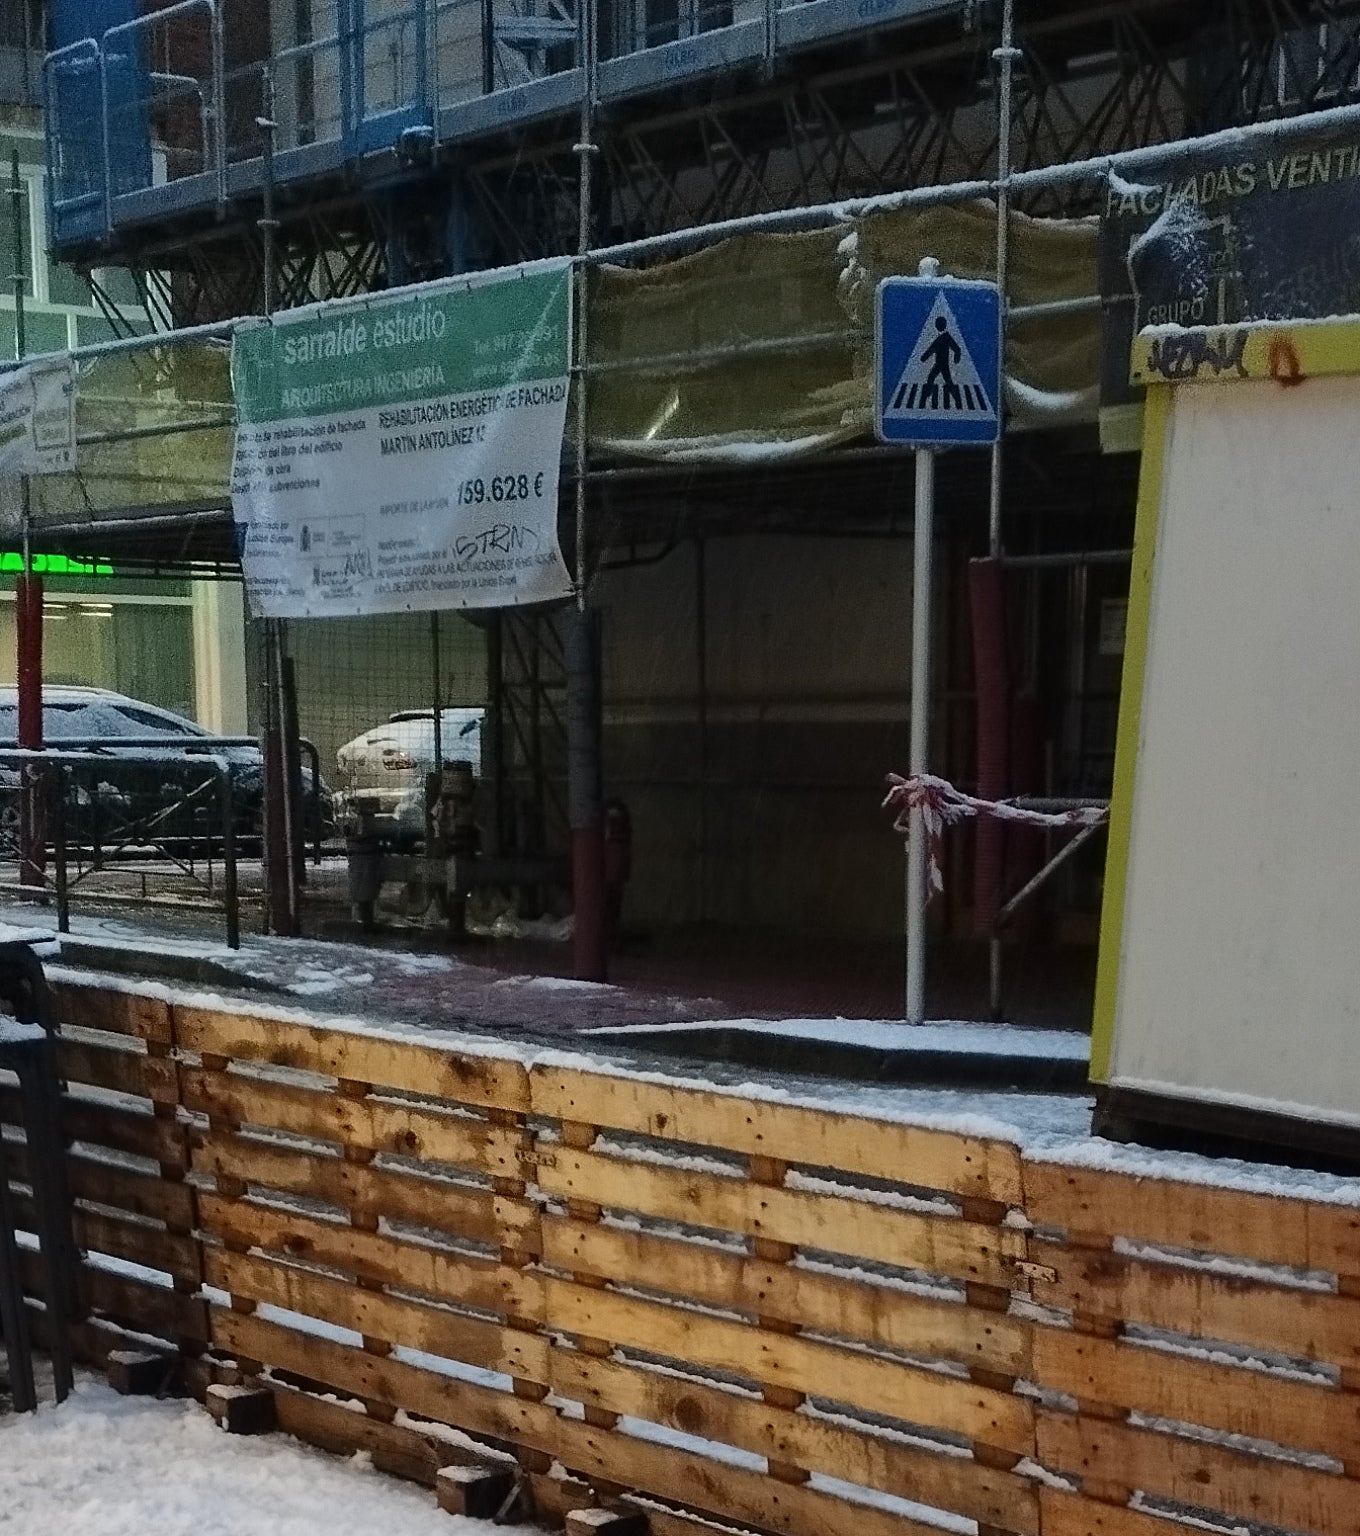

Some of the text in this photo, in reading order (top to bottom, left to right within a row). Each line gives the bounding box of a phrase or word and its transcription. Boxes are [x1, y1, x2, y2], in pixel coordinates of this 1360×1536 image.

[1105, 162, 1258, 218] FACHADAS
[1147, 297, 1205, 325] GRUPO
[284, 302, 446, 365] sarralde estudio
[450, 394, 502, 418] ENERGÉTIC
[533, 471, 544, 497] €
